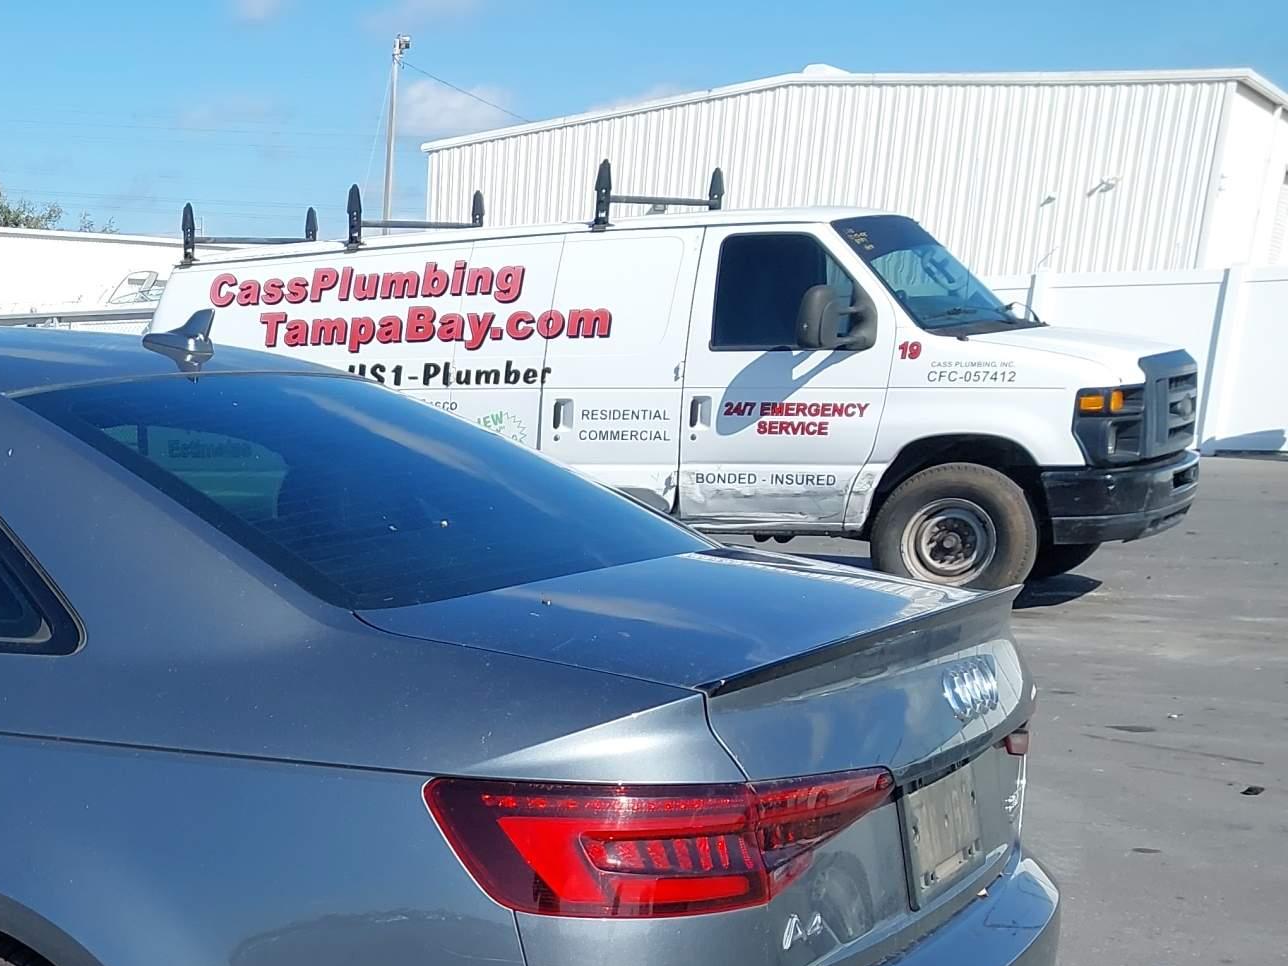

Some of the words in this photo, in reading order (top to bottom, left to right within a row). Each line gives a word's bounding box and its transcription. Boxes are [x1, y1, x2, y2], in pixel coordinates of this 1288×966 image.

[210, 260, 525, 308] CassPlumbing
[260, 306, 612, 354] TampaBay.com
[898, 341, 922, 360] 19
[927, 370, 1017, 382] CFC-057412
[581, 408, 670, 420] RESIDENTIAL
[723, 402, 756, 416] 24/7
[759, 402, 870, 417] EMERGENCY
[578, 430, 671, 441] COMMERCIAL
[757, 421, 829, 436] SERVICE
[695, 473, 757, 485] BONDED
[770, 473, 836, 486] INSURED
[783, 912, 823, 950] A4
